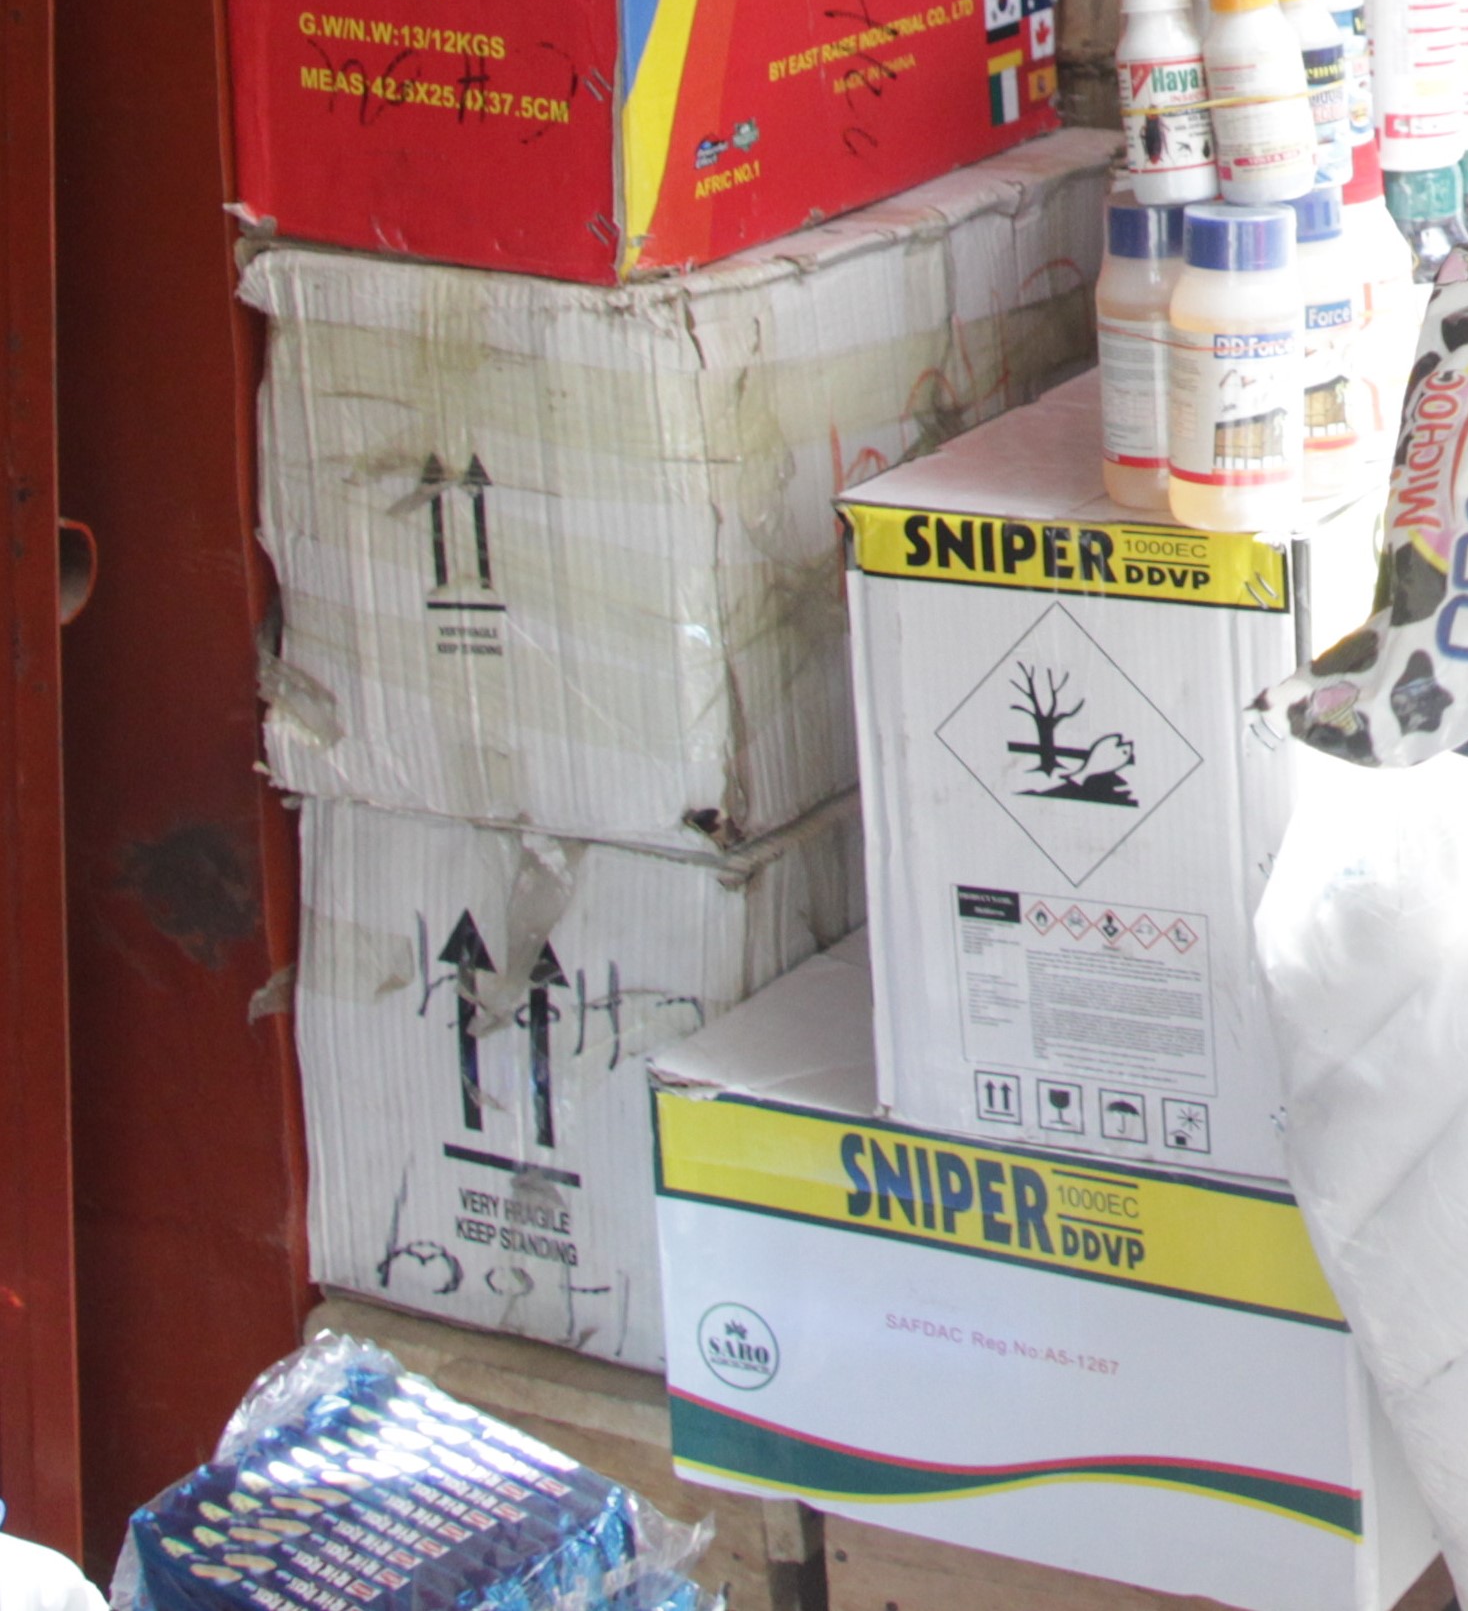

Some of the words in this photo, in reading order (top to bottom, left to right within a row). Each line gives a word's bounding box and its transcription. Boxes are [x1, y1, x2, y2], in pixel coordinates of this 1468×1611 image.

[768, 59, 787, 82] BY
[788, 49, 820, 76] EAST
[694, 168, 733, 200] AFRIC
[1307, 304, 1350, 329] Force
[1247, 336, 1296, 358] Force
[903, 515, 1119, 585] SNIPER
[1123, 538, 1208, 560] 1000EC
[1124, 564, 1211, 589] DDVP
[838, 1129, 1056, 1256] SNIPER
[1056, 1184, 1140, 1220] 1000EC
[458, 1187, 500, 1219] VERY
[503, 1198, 571, 1236] FRAGILE
[455, 1215, 497, 1246] KEEP
[499, 1226, 579, 1267] STANDING
[1060, 1228, 1146, 1273] DDVP
[884, 1312, 965, 1345] SAFDAC
[708, 1334, 770, 1365] SARO
